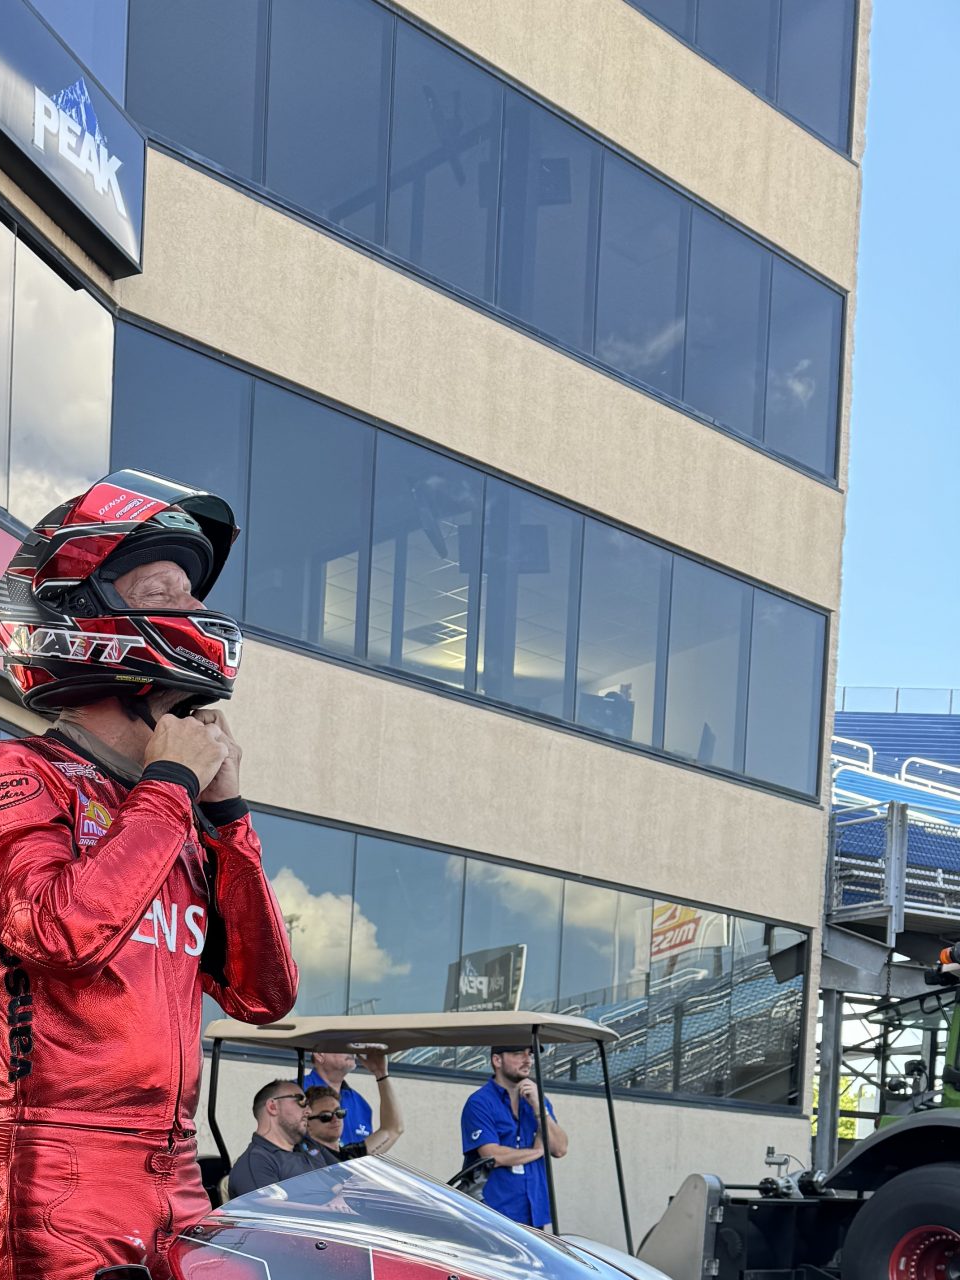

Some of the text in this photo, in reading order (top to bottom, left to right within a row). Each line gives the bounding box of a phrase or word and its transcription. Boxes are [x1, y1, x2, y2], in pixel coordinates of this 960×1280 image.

[33, 86, 127, 217] PEAK
[99, 494, 126, 515] DENSO
[130, 898, 205, 956] ENS
